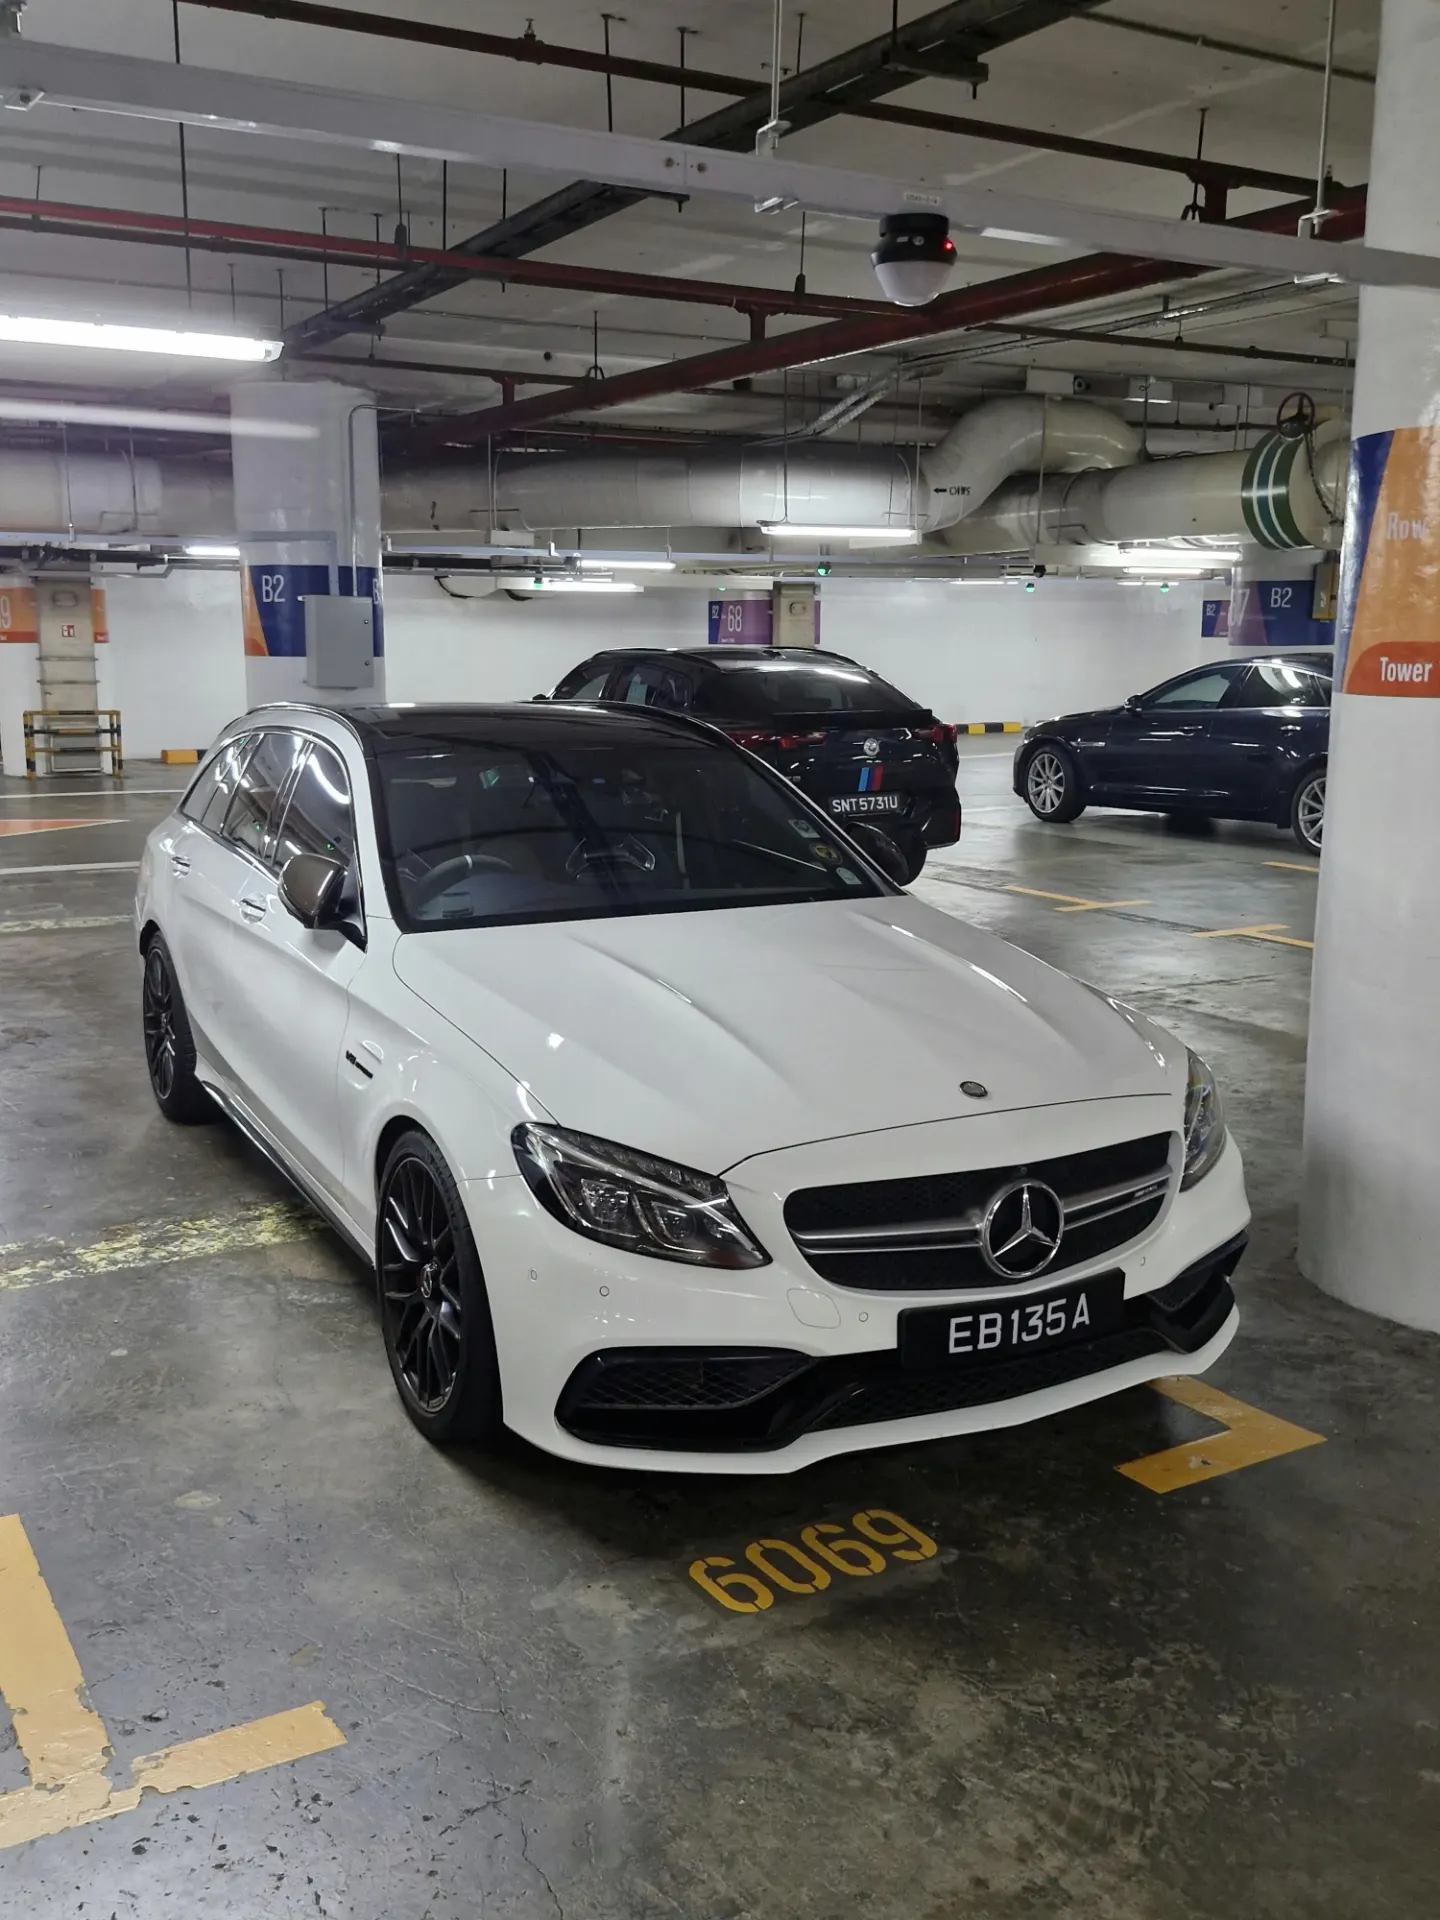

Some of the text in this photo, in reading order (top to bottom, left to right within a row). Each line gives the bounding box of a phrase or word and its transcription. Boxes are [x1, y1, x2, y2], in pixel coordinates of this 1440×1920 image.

[1386, 511, 1426, 541] Row
[261, 574, 286, 603] B2
[1270, 587, 1293, 608] B2
[727, 605, 743, 632] 68
[1206, 603, 1217, 617] B2
[1379, 656, 1433, 683] Tower
[831, 795, 899, 813] SNT5731U
[688, 1508, 939, 1614] 6069
